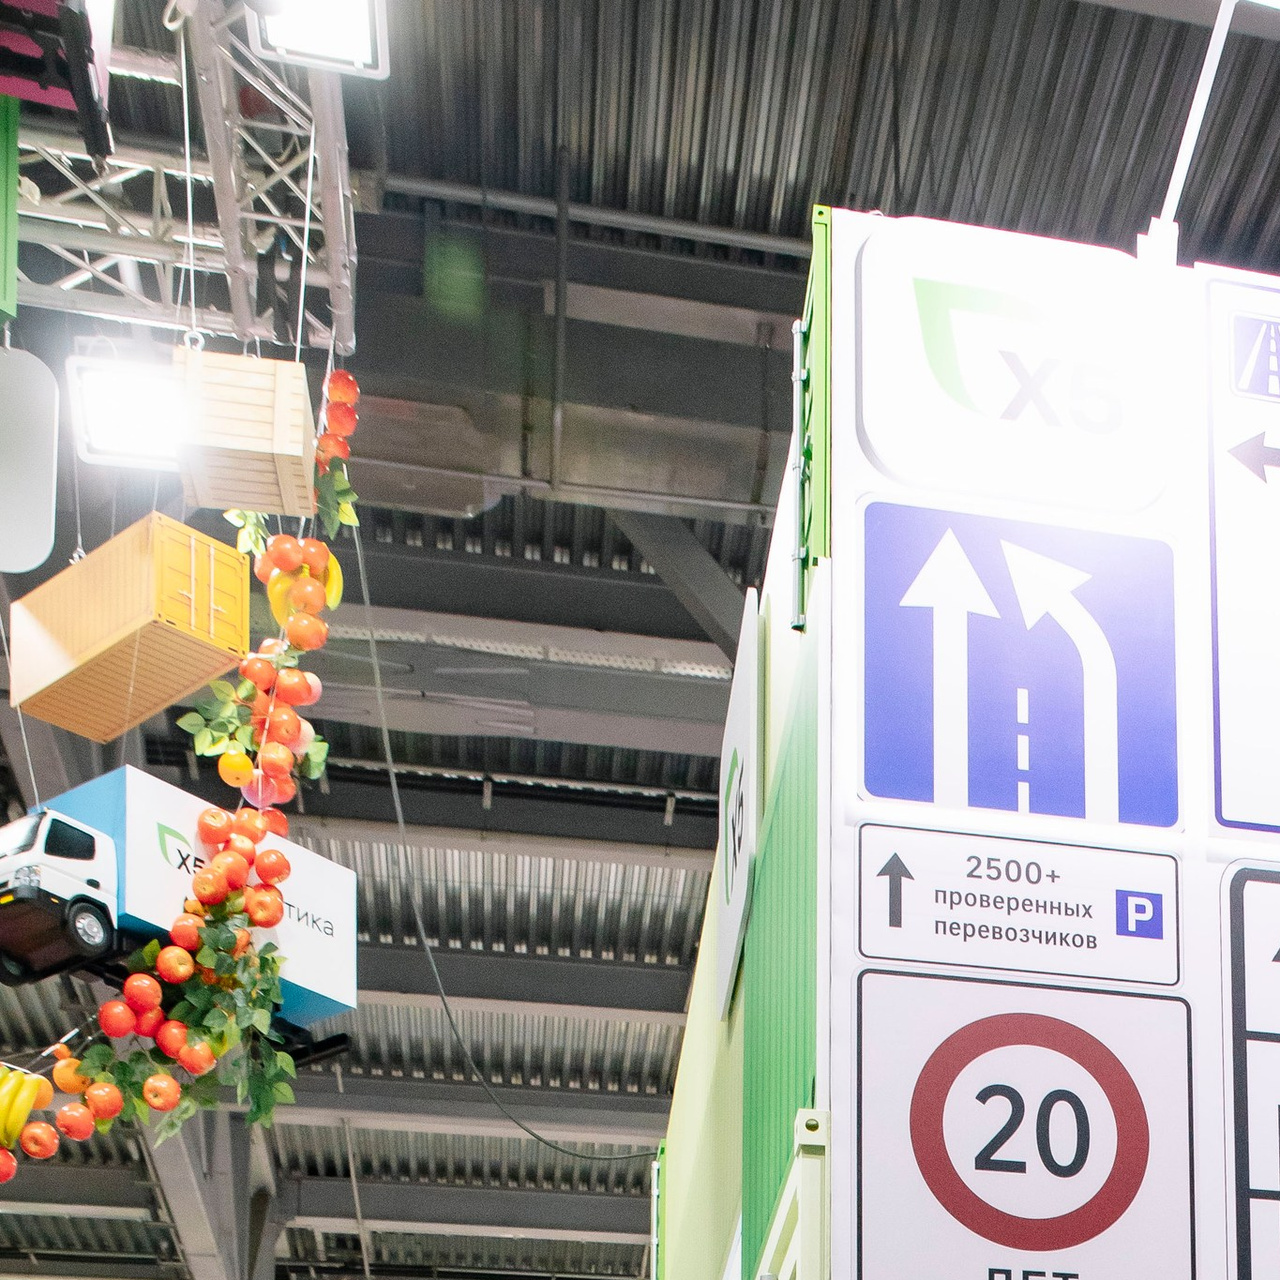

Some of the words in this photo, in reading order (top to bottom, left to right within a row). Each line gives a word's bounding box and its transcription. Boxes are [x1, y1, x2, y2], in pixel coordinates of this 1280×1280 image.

[966, 855, 1061, 884] 2500+
[285, 902, 335, 938] тика
[935, 889, 1093, 919] проверенных
[1127, 896, 1154, 932] P
[935, 920, 1098, 949] перевозчиков
[974, 1083, 1090, 1178] 20
